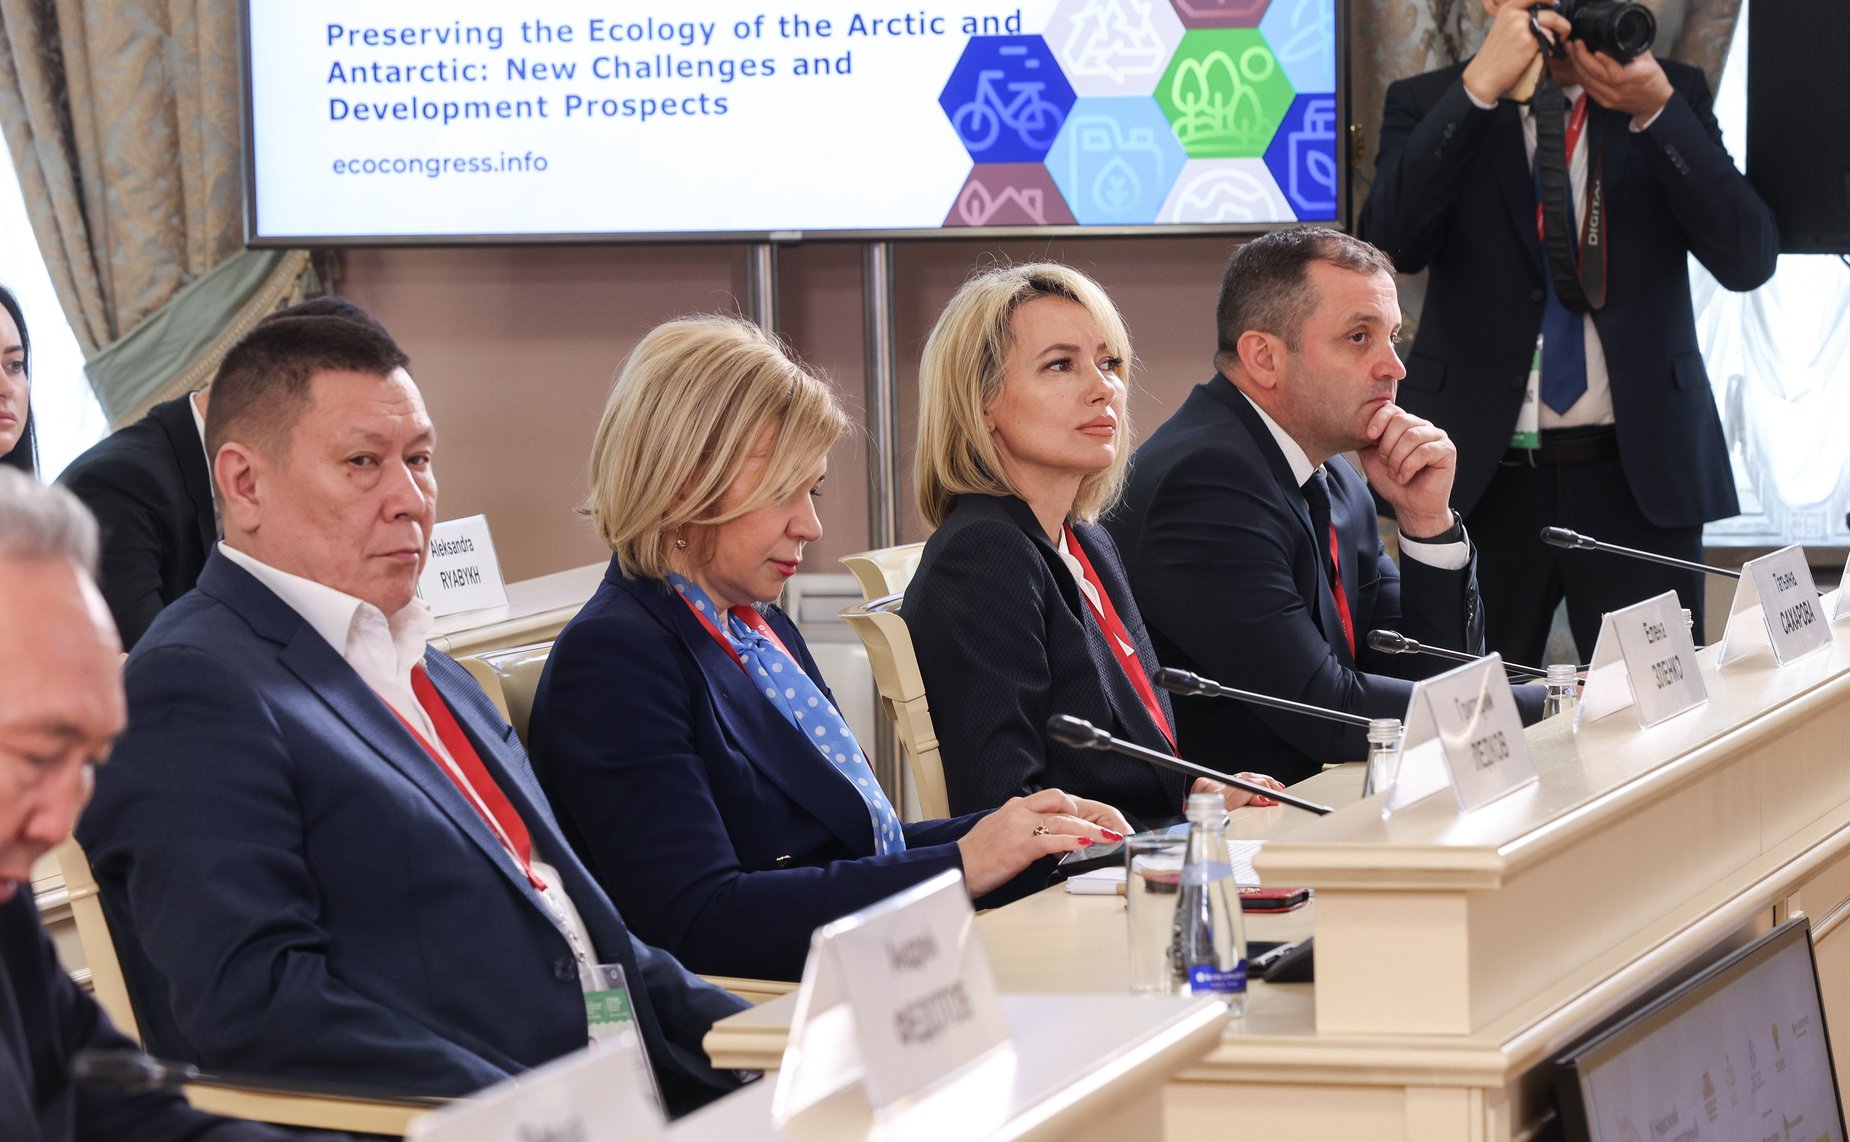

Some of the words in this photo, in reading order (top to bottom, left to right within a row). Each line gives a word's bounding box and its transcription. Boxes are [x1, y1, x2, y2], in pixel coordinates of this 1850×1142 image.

[327, 20, 503, 50] Preserving
[521, 19, 573, 43] the
[589, 17, 715, 47] Ecology
[733, 14, 765, 40] of
[778, 14, 832, 39] the
[847, 10, 945, 37] Arctic
[961, 9, 1022, 35] and
[327, 58, 487, 84] Antarctic:
[507, 58, 576, 81] New
[592, 54, 776, 84] Challenges
[793, 50, 852, 76] and
[329, 96, 548, 126] Development
[565, 93, 728, 123] Prospects
[332, 151, 548, 178] ecocongress.info
[430, 536, 474, 558] Aleksandra
[440, 566, 481, 589] RYABYKH
[1779, 600, 1817, 635] САХАРОВА
